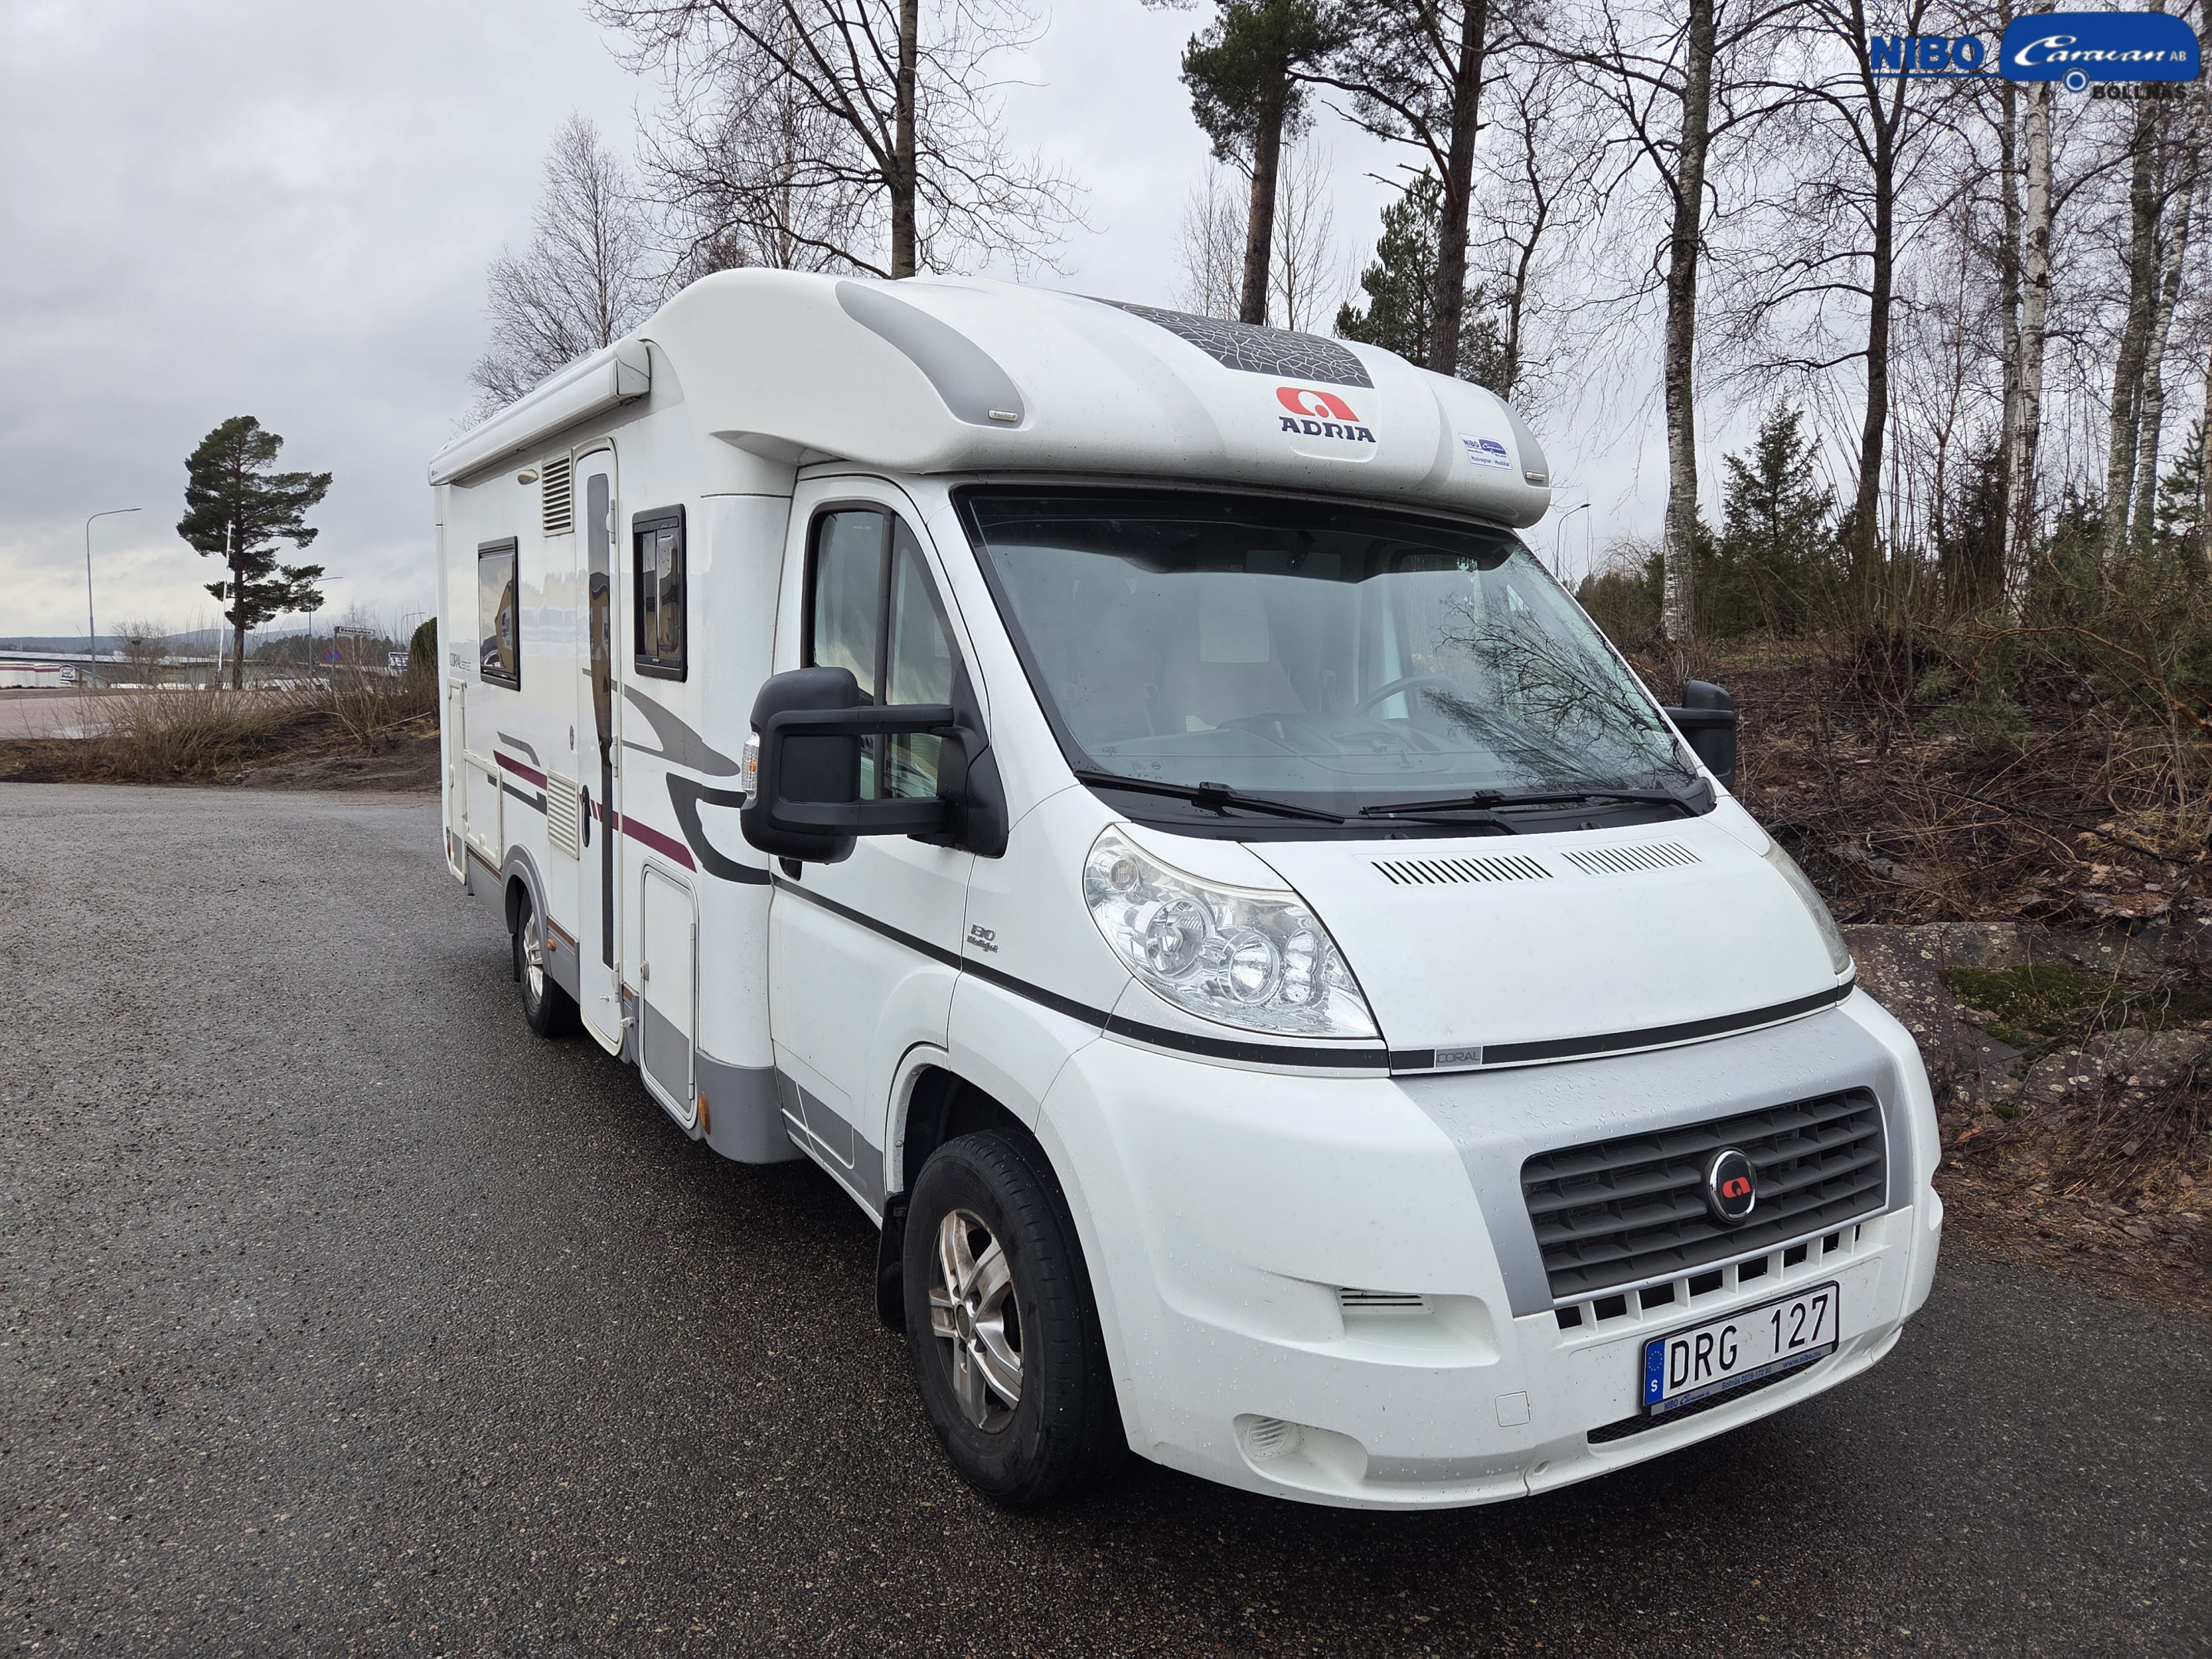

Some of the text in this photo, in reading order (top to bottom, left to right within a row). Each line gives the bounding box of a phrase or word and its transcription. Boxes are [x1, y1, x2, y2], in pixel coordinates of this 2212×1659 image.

[1279, 416, 1376, 442] ADRIA
[1463, 439, 1479, 447] NIBO
[1437, 1051, 1480, 1063] CORAL
[1670, 1293, 1829, 1389] DRG 127
[1651, 1379, 1658, 1392] S
[1664, 1399, 1678, 1411] NIBO
[1783, 1350, 1821, 1368] www.nibo.nu
